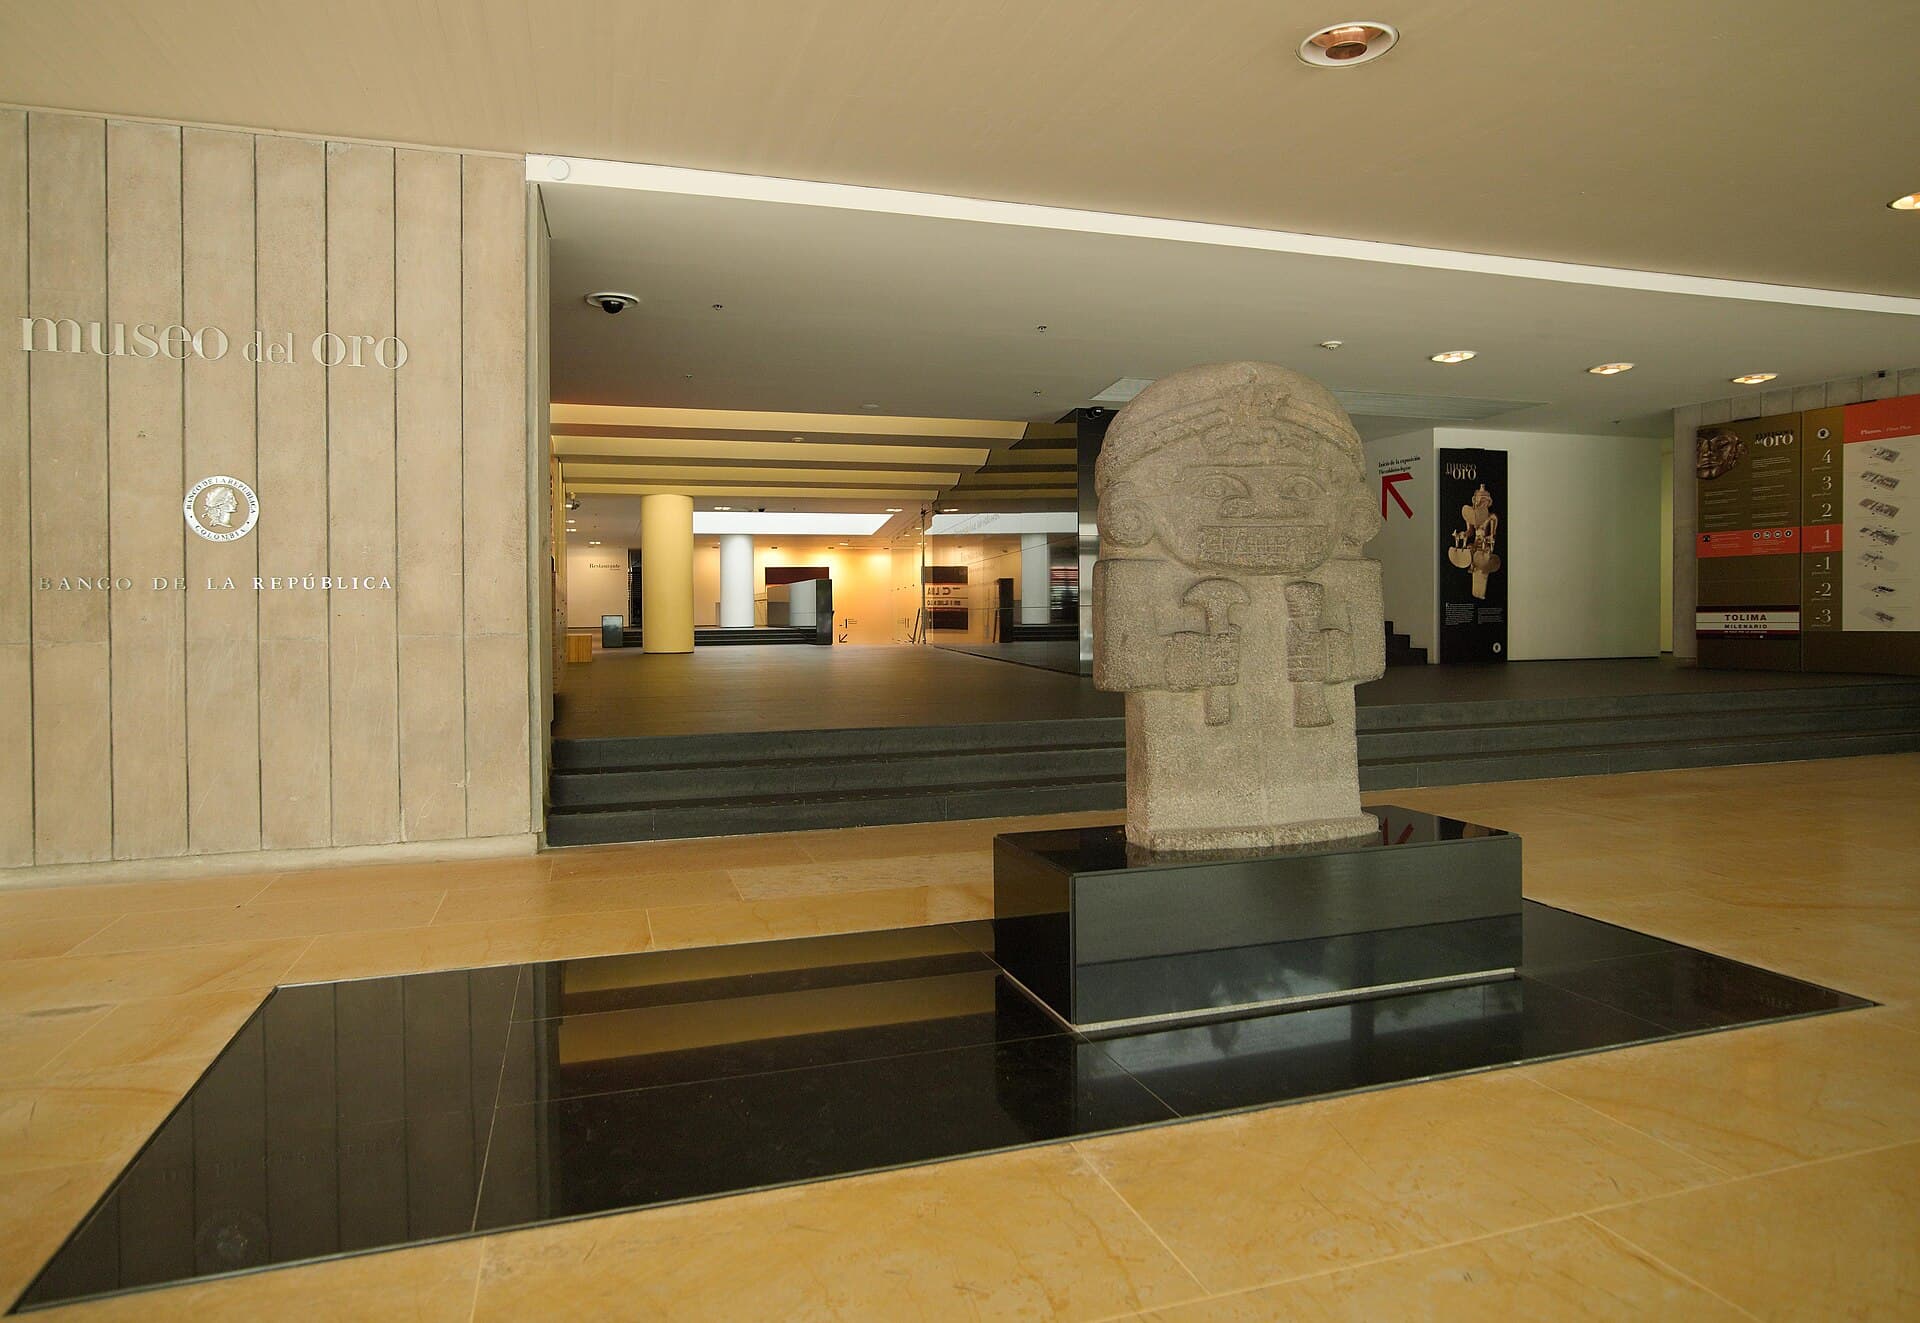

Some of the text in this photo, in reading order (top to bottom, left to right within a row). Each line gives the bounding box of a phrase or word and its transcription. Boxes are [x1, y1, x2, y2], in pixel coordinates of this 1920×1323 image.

[19, 316, 409, 370] museo del oro
[1763, 434, 1793, 448] oro
[1823, 449, 1832, 464] 4
[1452, 469, 1477, 481] oro
[1822, 476, 1832, 490] 3
[1822, 503, 1832, 517] 2
[195, 525, 246, 540] COLOMBIA
[1824, 529, 1830, 543] 1
[1816, 556, 1830, 570] -1
[38, 572, 392, 591] BANCO DE LA REPÚBLICA
[1815, 582, 1831, 597] -2
[1815, 608, 1832, 623] -3
